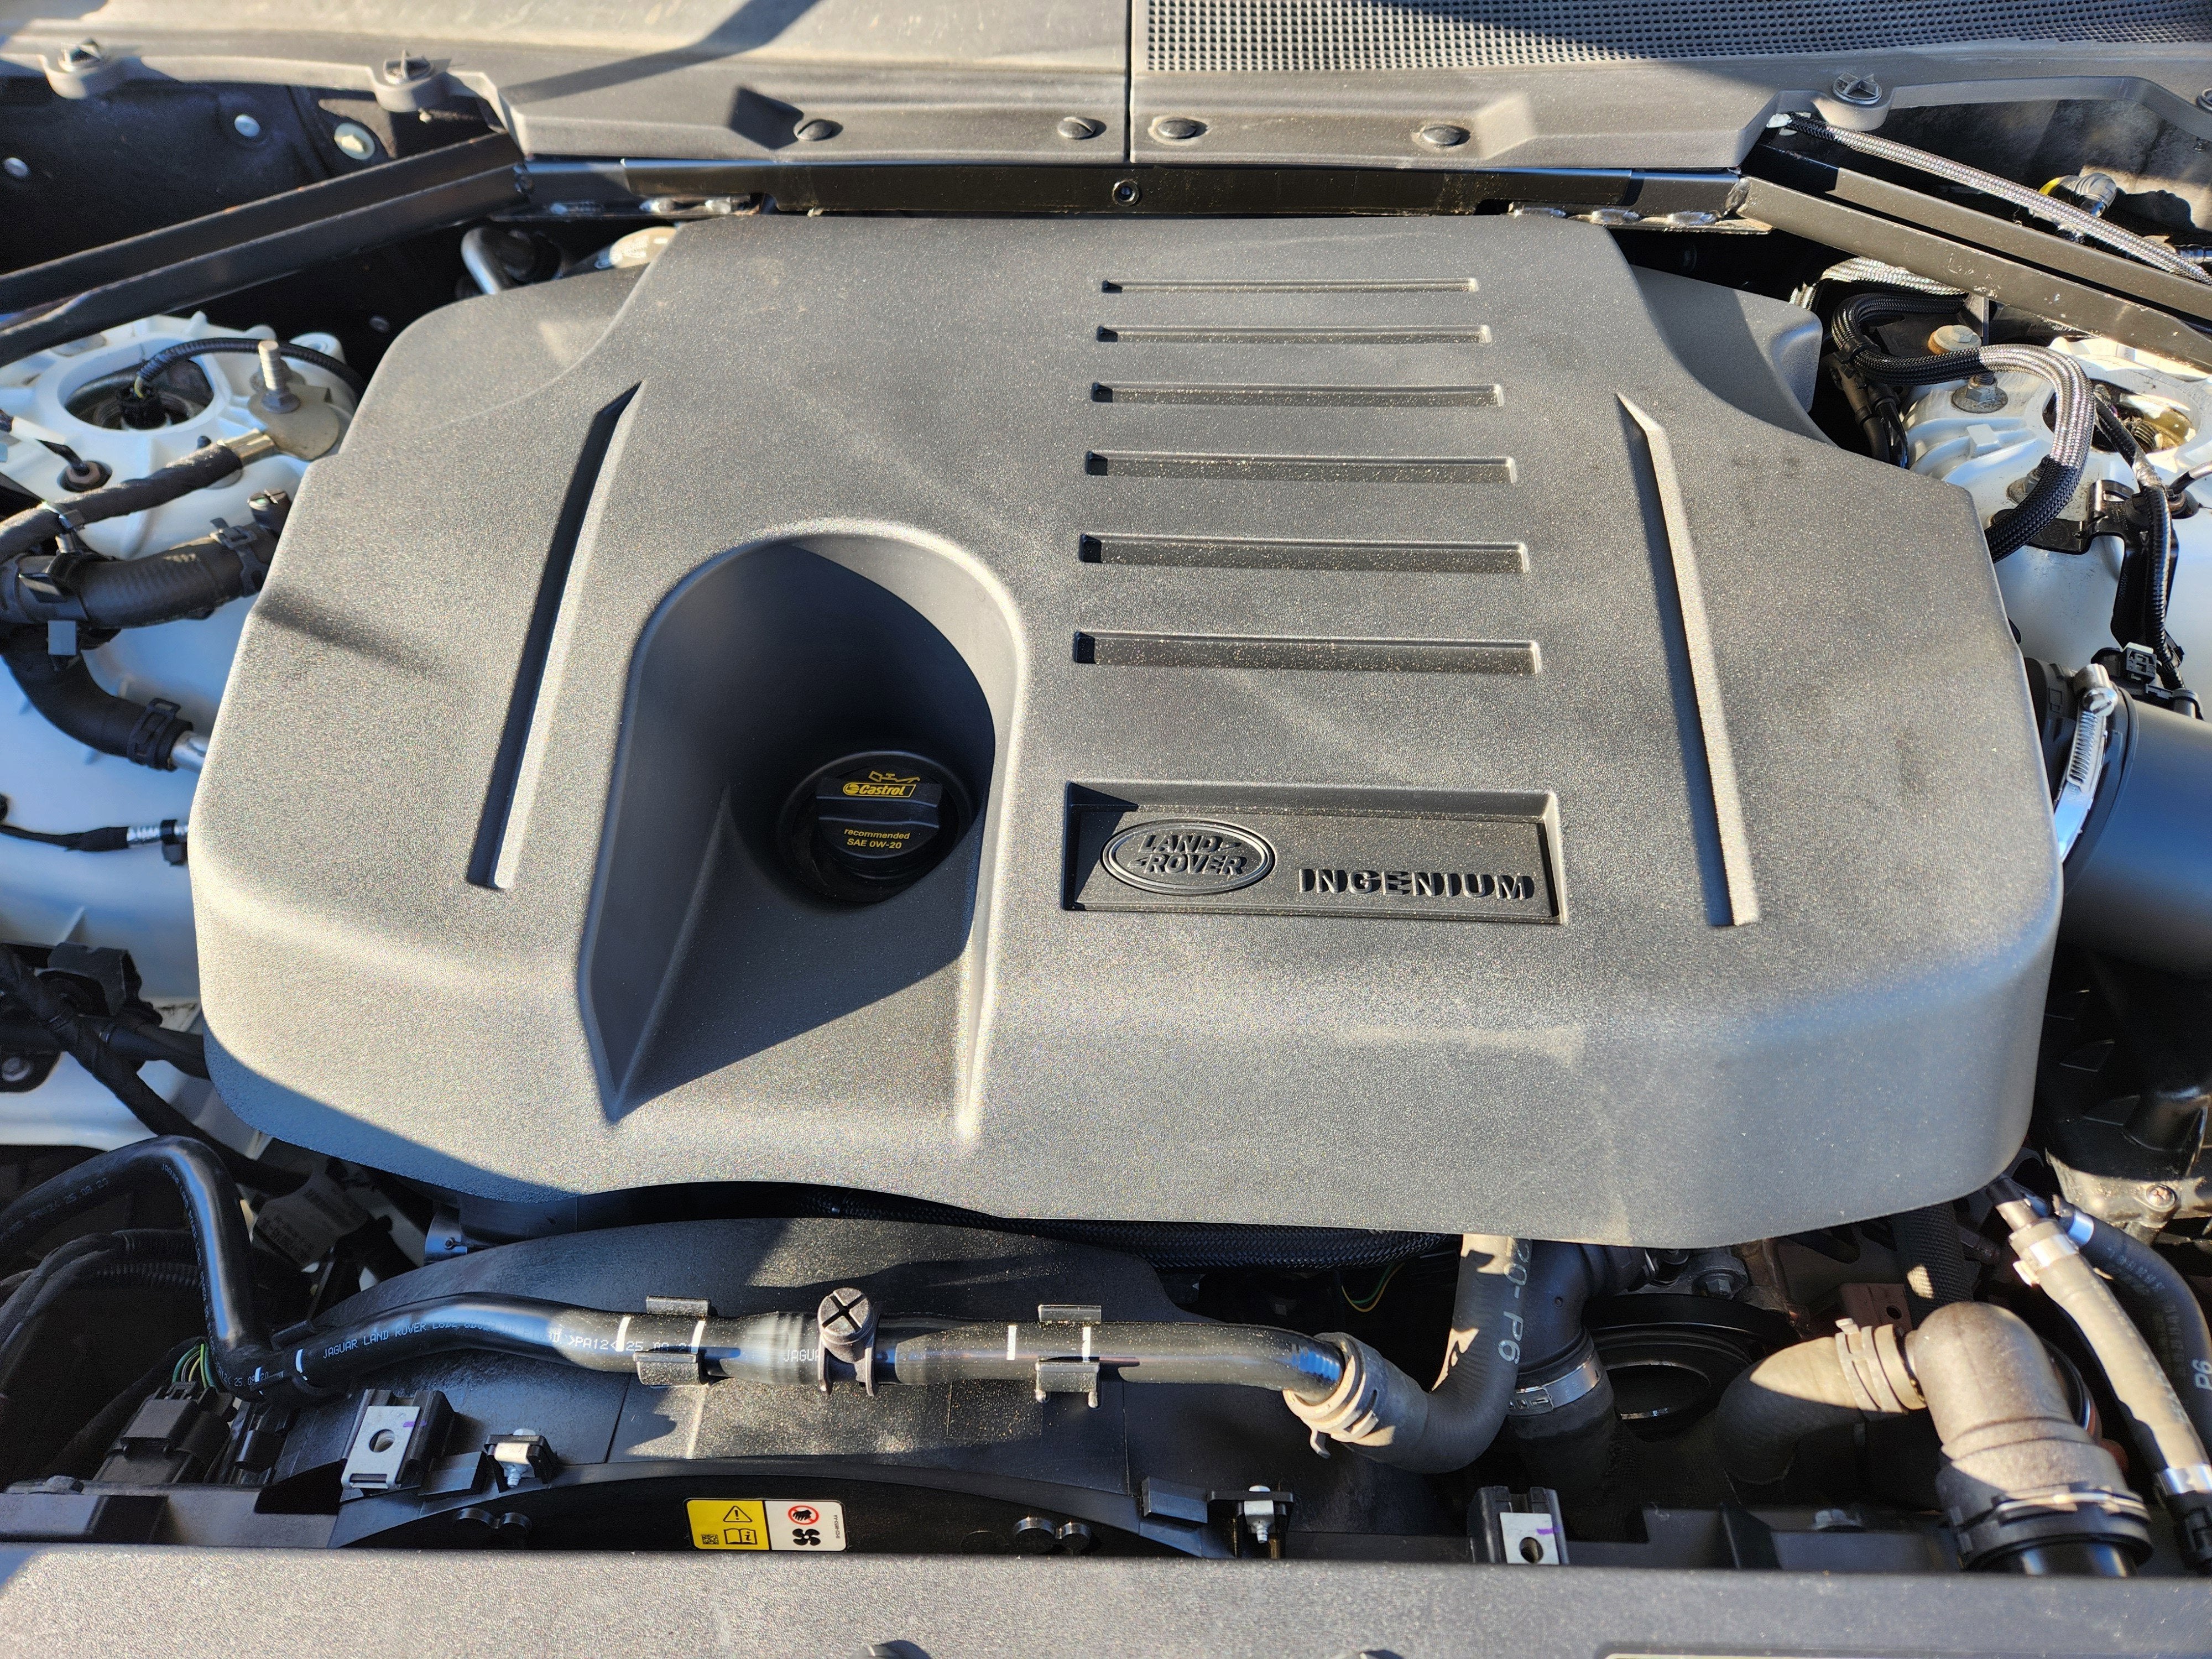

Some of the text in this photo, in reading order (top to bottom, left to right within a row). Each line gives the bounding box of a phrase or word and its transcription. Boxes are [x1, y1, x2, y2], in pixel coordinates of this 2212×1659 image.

[859, 784, 905, 795] Castrol
[844, 828, 910, 839] recommended
[847, 838, 902, 849] SAE 0W-20
[1139, 834, 1224, 854] LAND
[1145, 852, 1248, 876] ROVER
[1298, 868, 1535, 900] INGENIUM
[322, 1338, 358, 1359] JAGUAR
[363, 1329, 389, 1346] LAND
[394, 1322, 427, 1338] ROVER
[1498, 1311, 1524, 1364] P6
